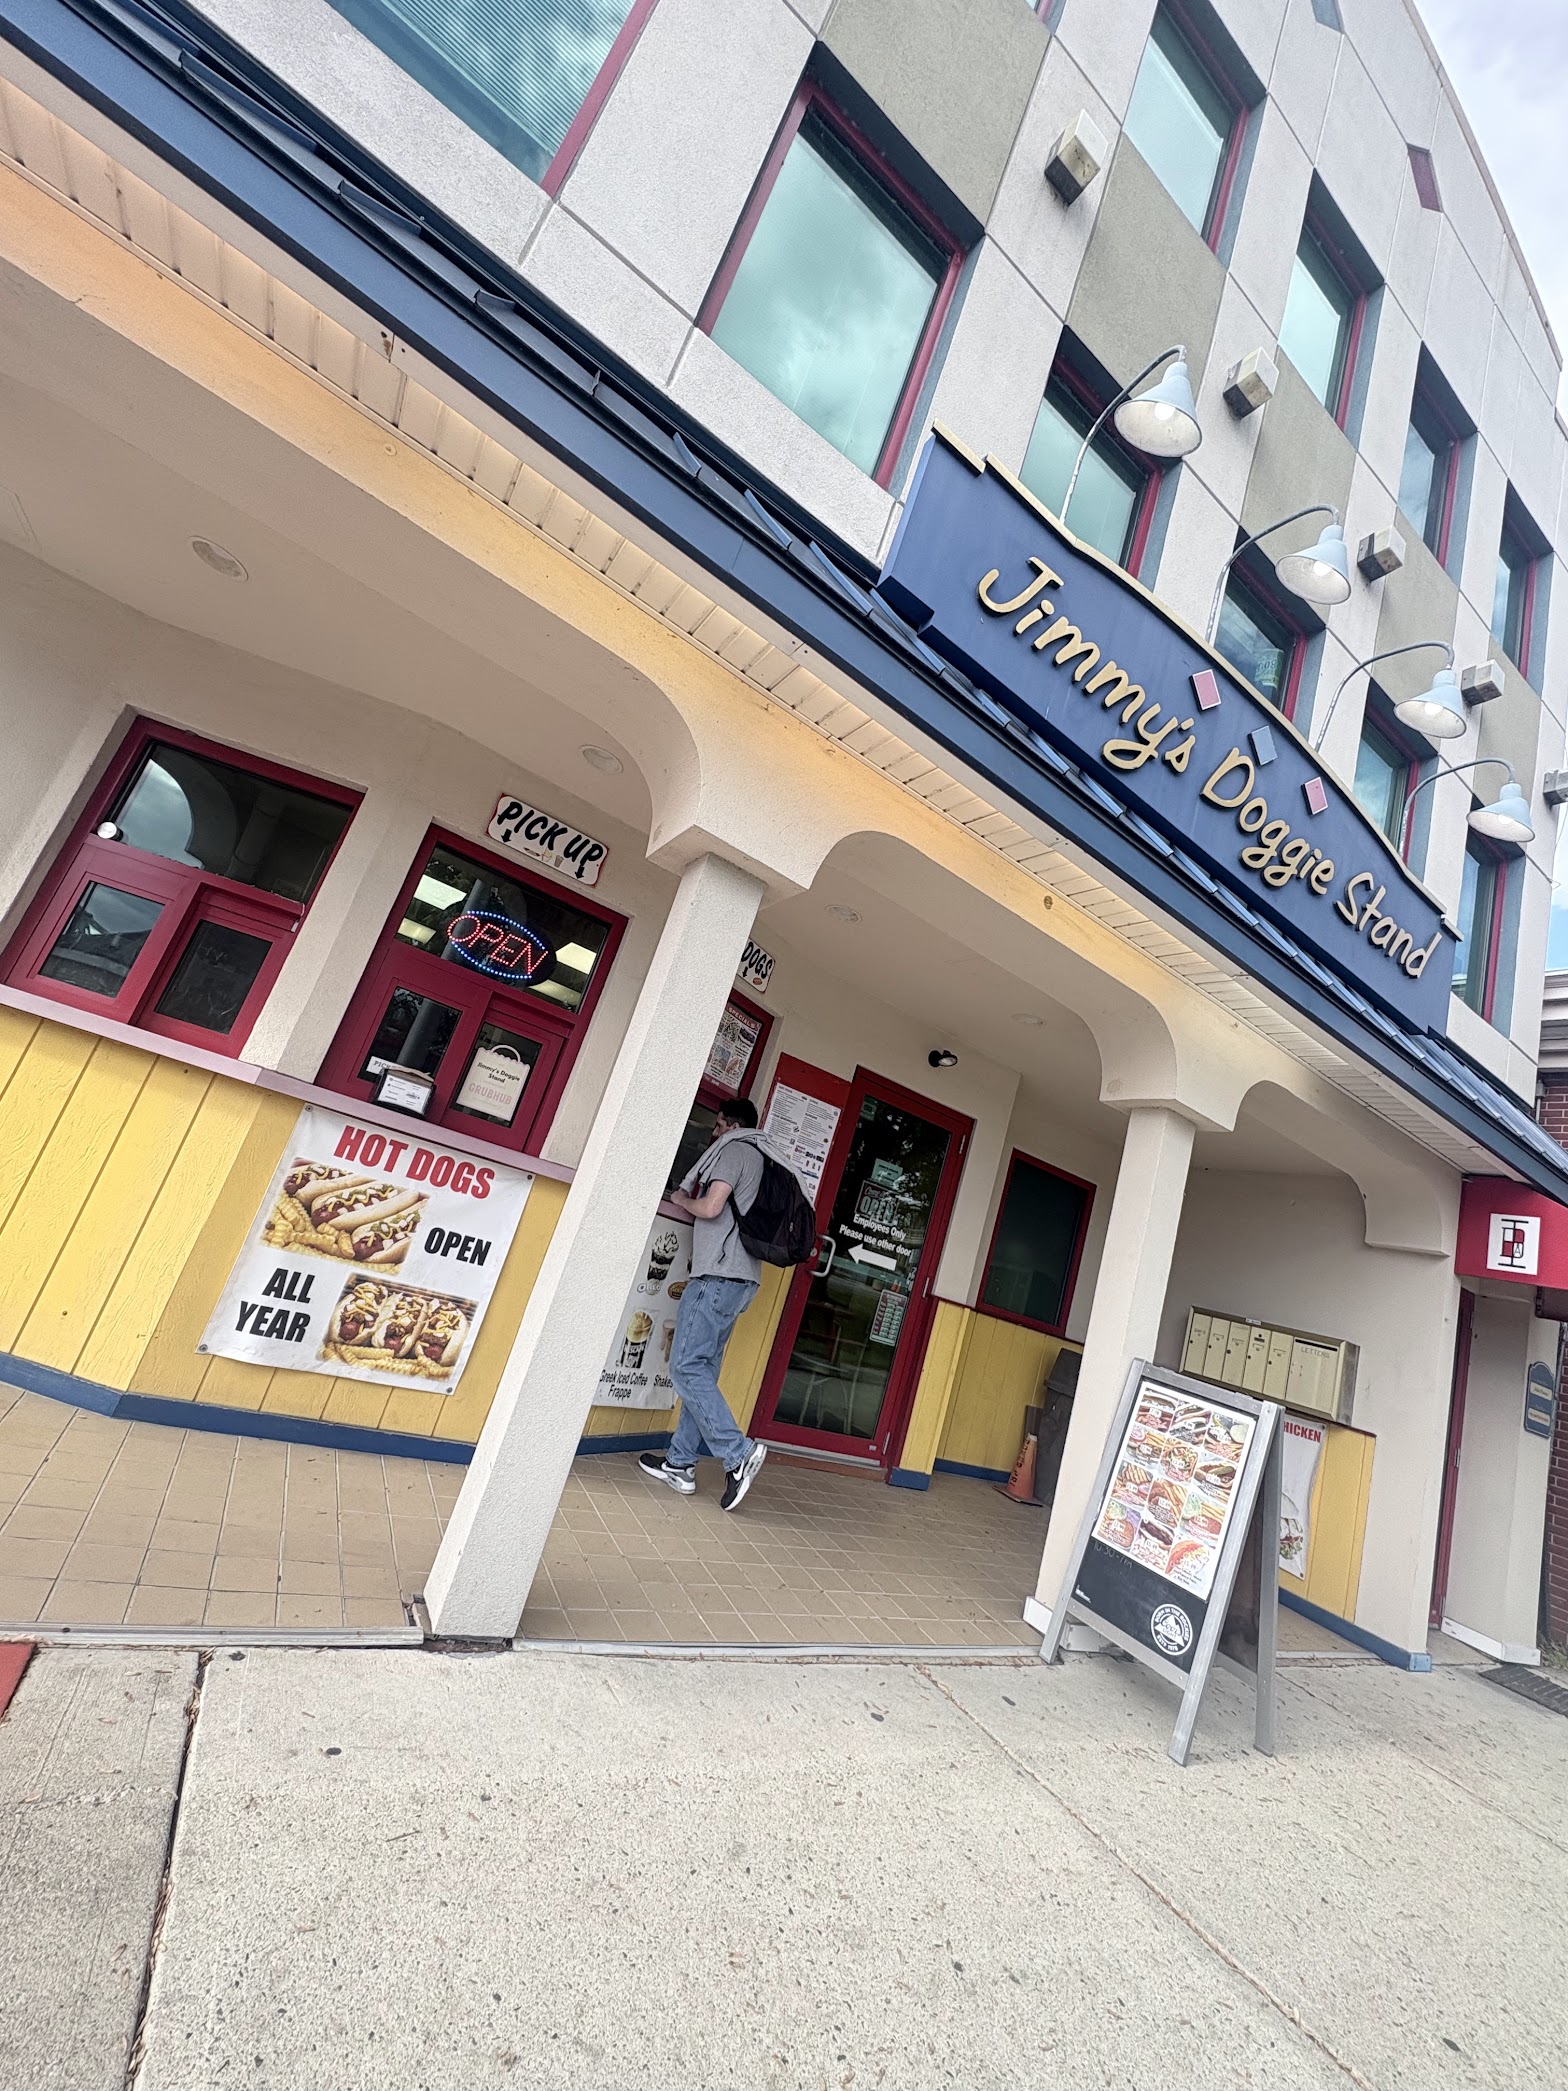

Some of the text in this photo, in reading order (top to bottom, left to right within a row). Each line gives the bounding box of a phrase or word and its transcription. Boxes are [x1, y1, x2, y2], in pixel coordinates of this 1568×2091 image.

[977, 556, 1443, 980] Jimmy's Doggie Stand
[497, 801, 605, 867] PICK UP
[447, 914, 548, 975] OPEN
[741, 942, 773, 979] DOGS
[487, 1072, 506, 1085] Stand
[499, 1068, 521, 1083] Doggie
[469, 1082, 512, 1106] GRUBHUB
[333, 1125, 496, 1200] HOT DOGS
[839, 1224, 912, 1257] Please use other door
[853, 1214, 906, 1241] Employees Only
[423, 1227, 493, 1267] OPEN
[261, 1267, 316, 1304] ALL
[235, 1301, 311, 1343] YEAR
[1301, 1346, 1330, 1358] LETTERS
[608, 1384, 632, 1399] Frappe
[616, 1370, 630, 1385] Iced
[629, 1372, 648, 1386] Coffee
[653, 1374, 674, 1389] Shakes
